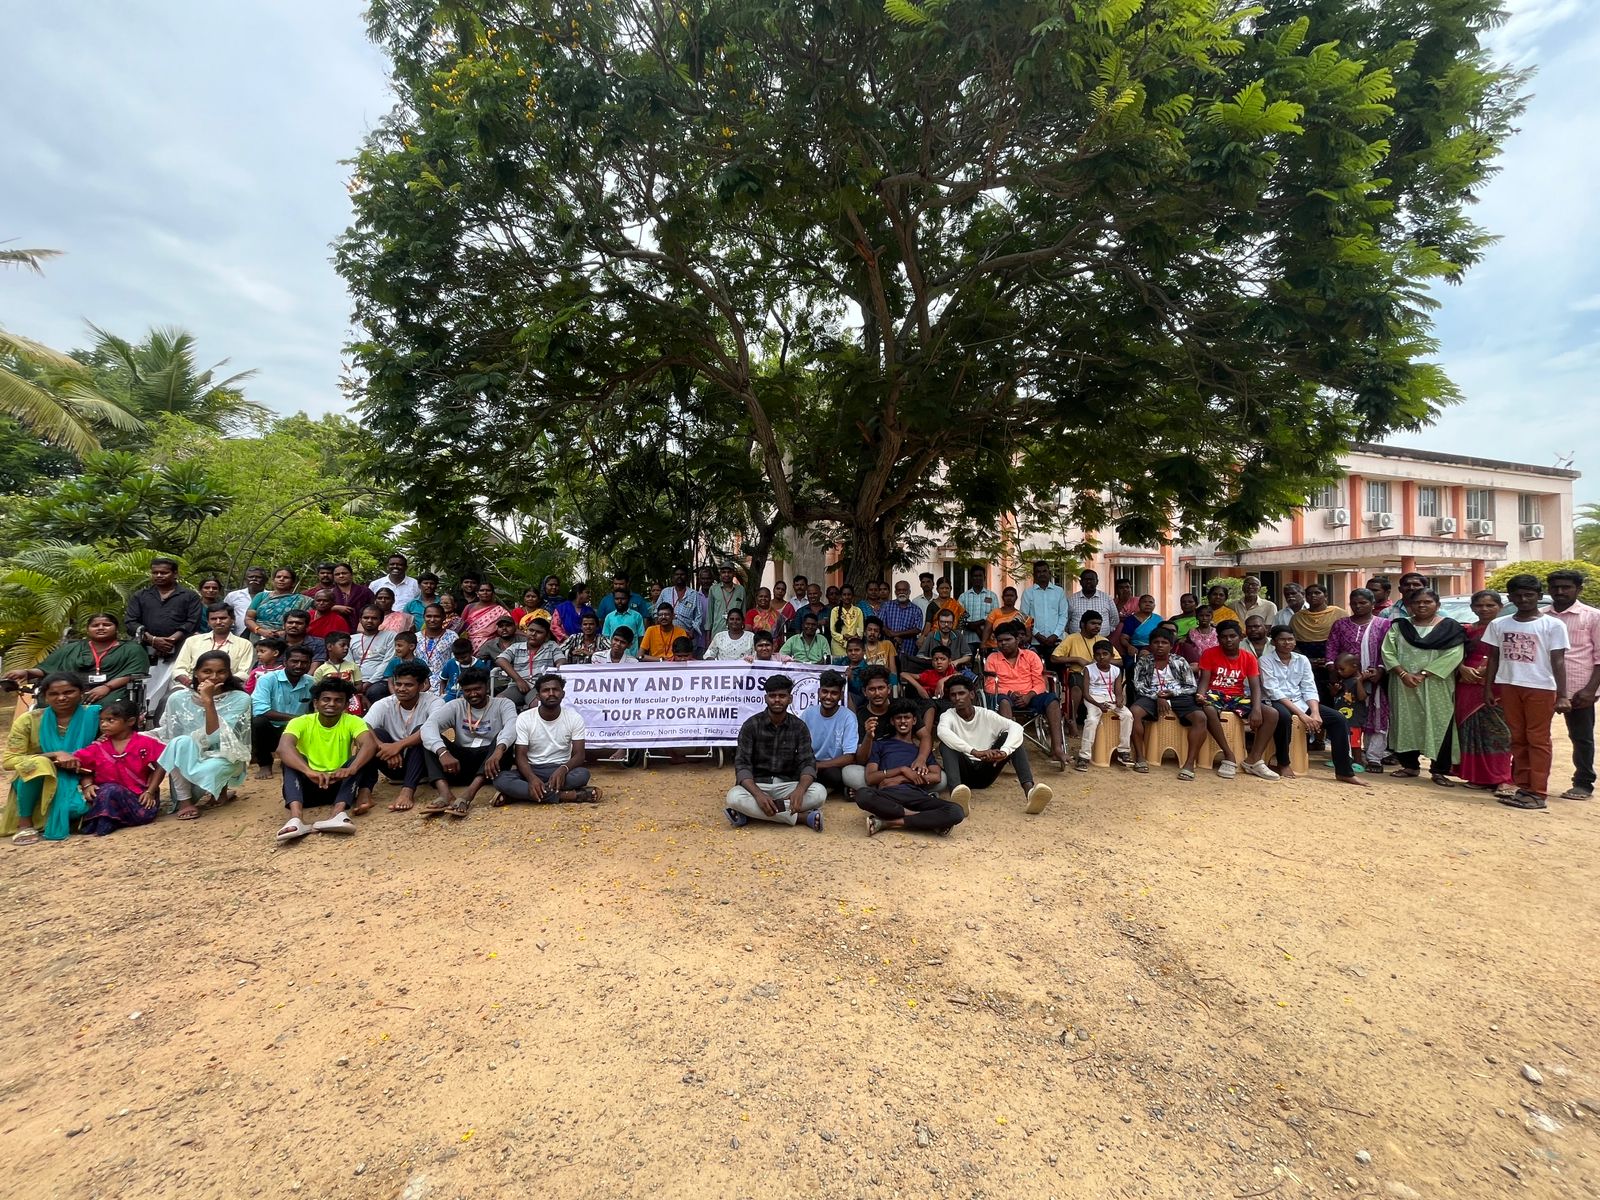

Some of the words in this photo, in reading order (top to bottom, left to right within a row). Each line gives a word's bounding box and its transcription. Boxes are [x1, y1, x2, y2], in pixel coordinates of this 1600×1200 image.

[1217, 666, 1241, 679] PLAY
[573, 678, 639, 693] DANNY
[644, 676, 684, 692] AND
[690, 675, 767, 691] FRIENDS
[573, 697, 620, 705] Association
[634, 696, 669, 704] Muscular
[671, 695, 709, 704] Dystrophy
[711, 694, 742, 702] Patients
[743, 695, 764, 704] (NGO)
[602, 709, 642, 721] TOUR
[646, 707, 739, 720] PROGRAMME
[678, 727, 702, 735] Street,
[704, 727, 725, 736] Trichy
